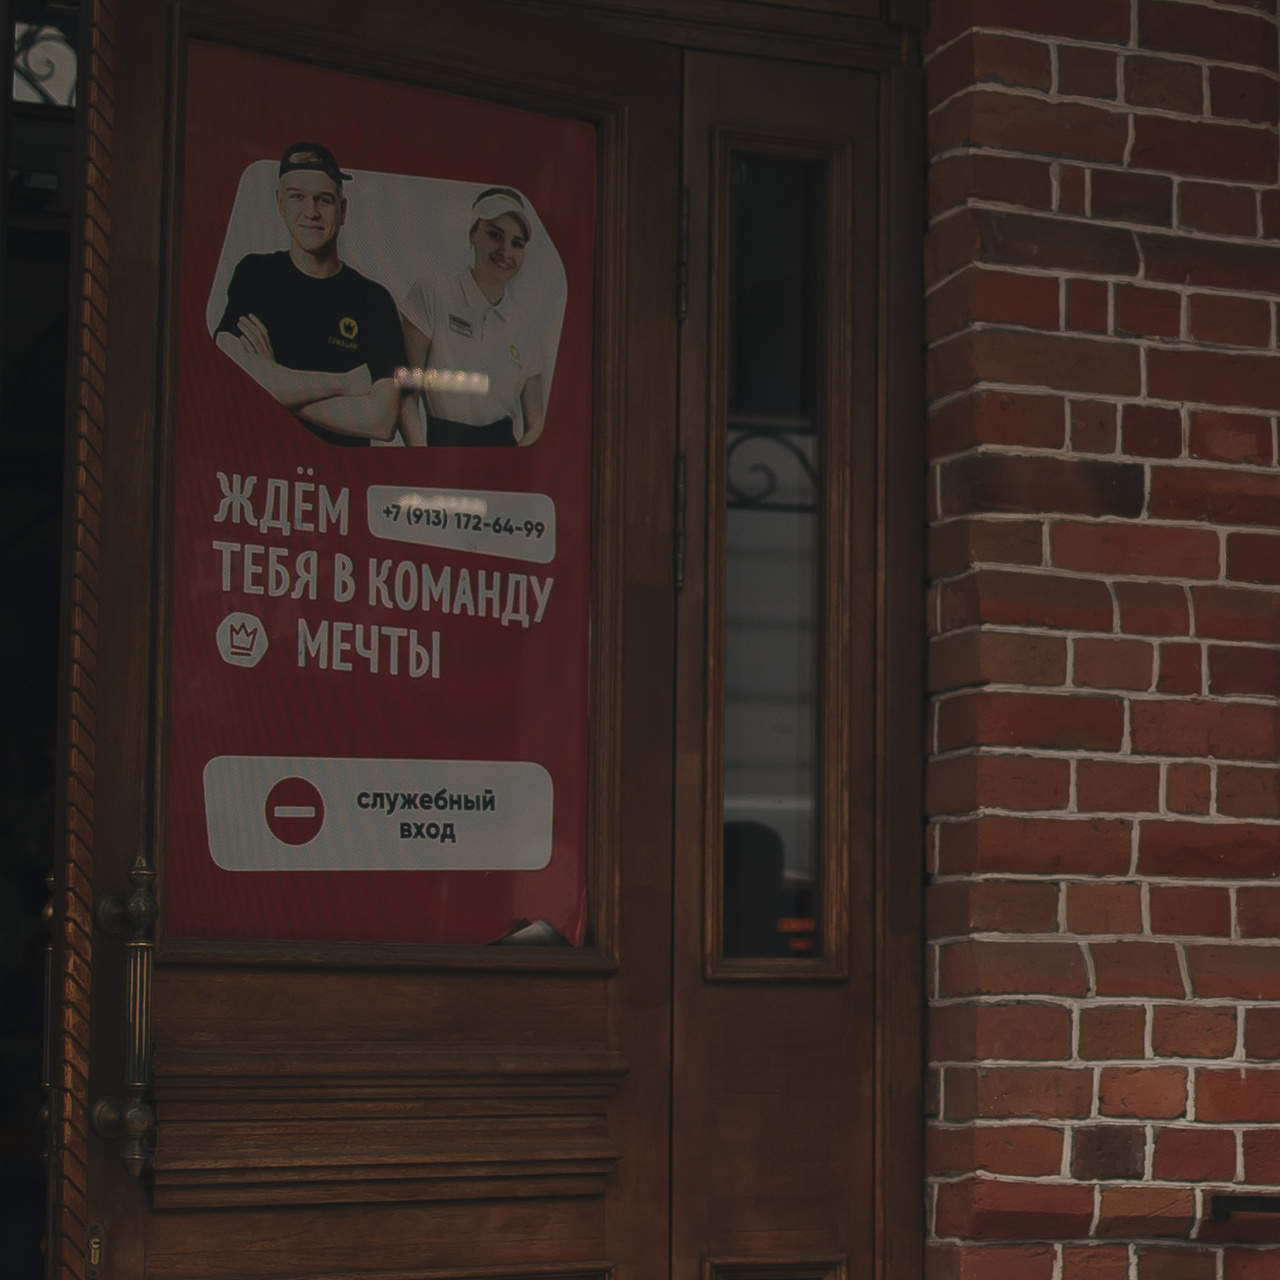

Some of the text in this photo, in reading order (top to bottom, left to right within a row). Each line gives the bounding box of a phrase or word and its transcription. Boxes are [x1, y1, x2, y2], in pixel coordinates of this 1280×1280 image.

[214, 466, 350, 536] ЖДЁМ
[382, 504, 545, 539] +7 (913) 172-64-99
[213, 540, 554, 628] ТЕБЯ В КОМАНДУ
[297, 618, 441, 679] МЕЧТЫ
[356, 789, 497, 815] служебный
[399, 821, 457, 844] вход
